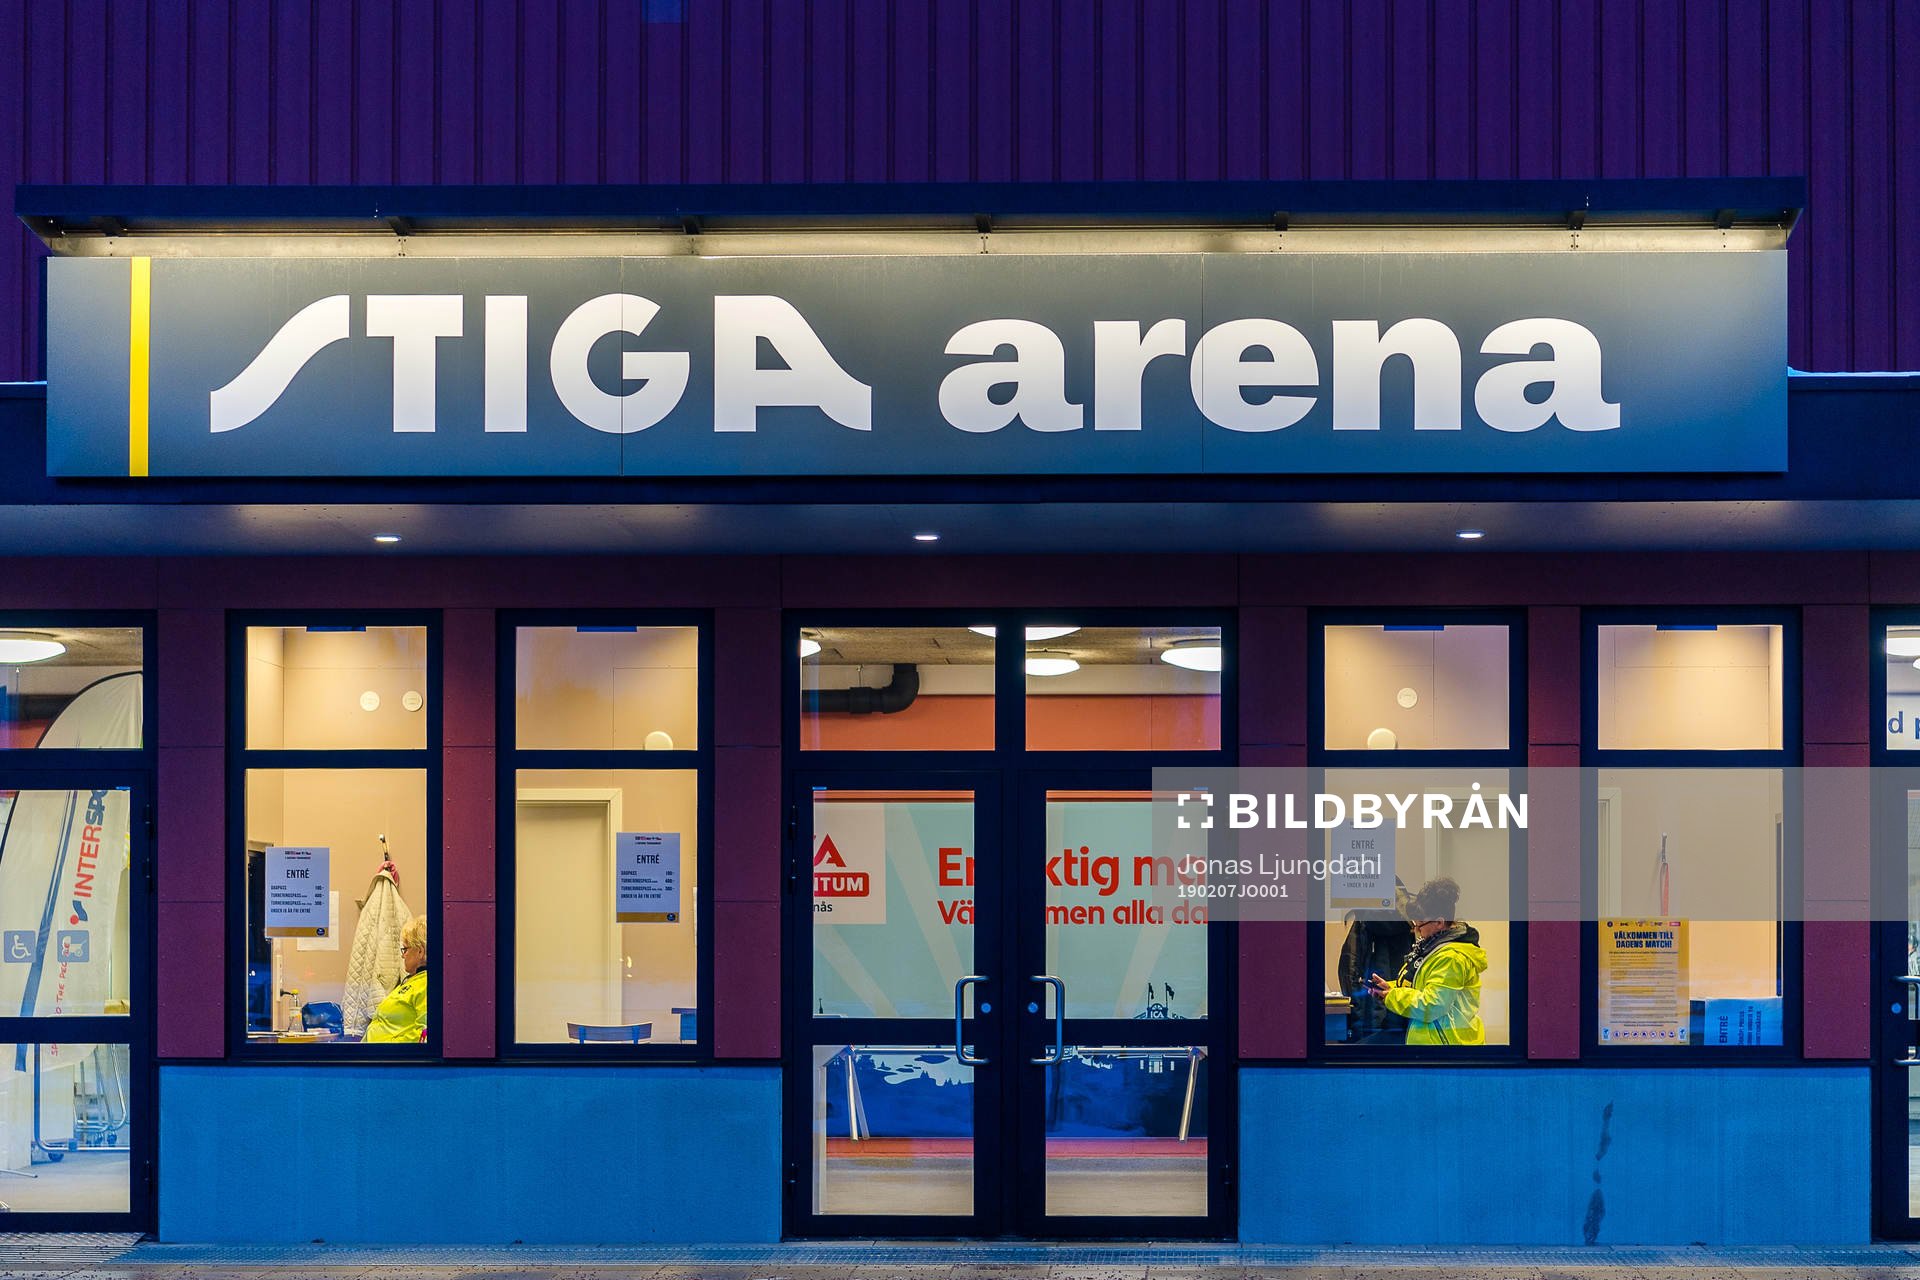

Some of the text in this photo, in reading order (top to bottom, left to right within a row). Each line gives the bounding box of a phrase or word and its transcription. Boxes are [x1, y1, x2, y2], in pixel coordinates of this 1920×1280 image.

[210, 293, 1621, 433] STIGA arena
[1351, 839, 1375, 849] ENTRÉ
[636, 853, 660, 864] ENTRÉ
[286, 868, 310, 879] ENTRÉ
[1046, 846, 1119, 896] ktig
[1113, 900, 1164, 925] alla
[1614, 931, 1674, 939] VÄLKOMMEN TILL
[1616, 940, 1672, 948] DAGENS MATCH!
